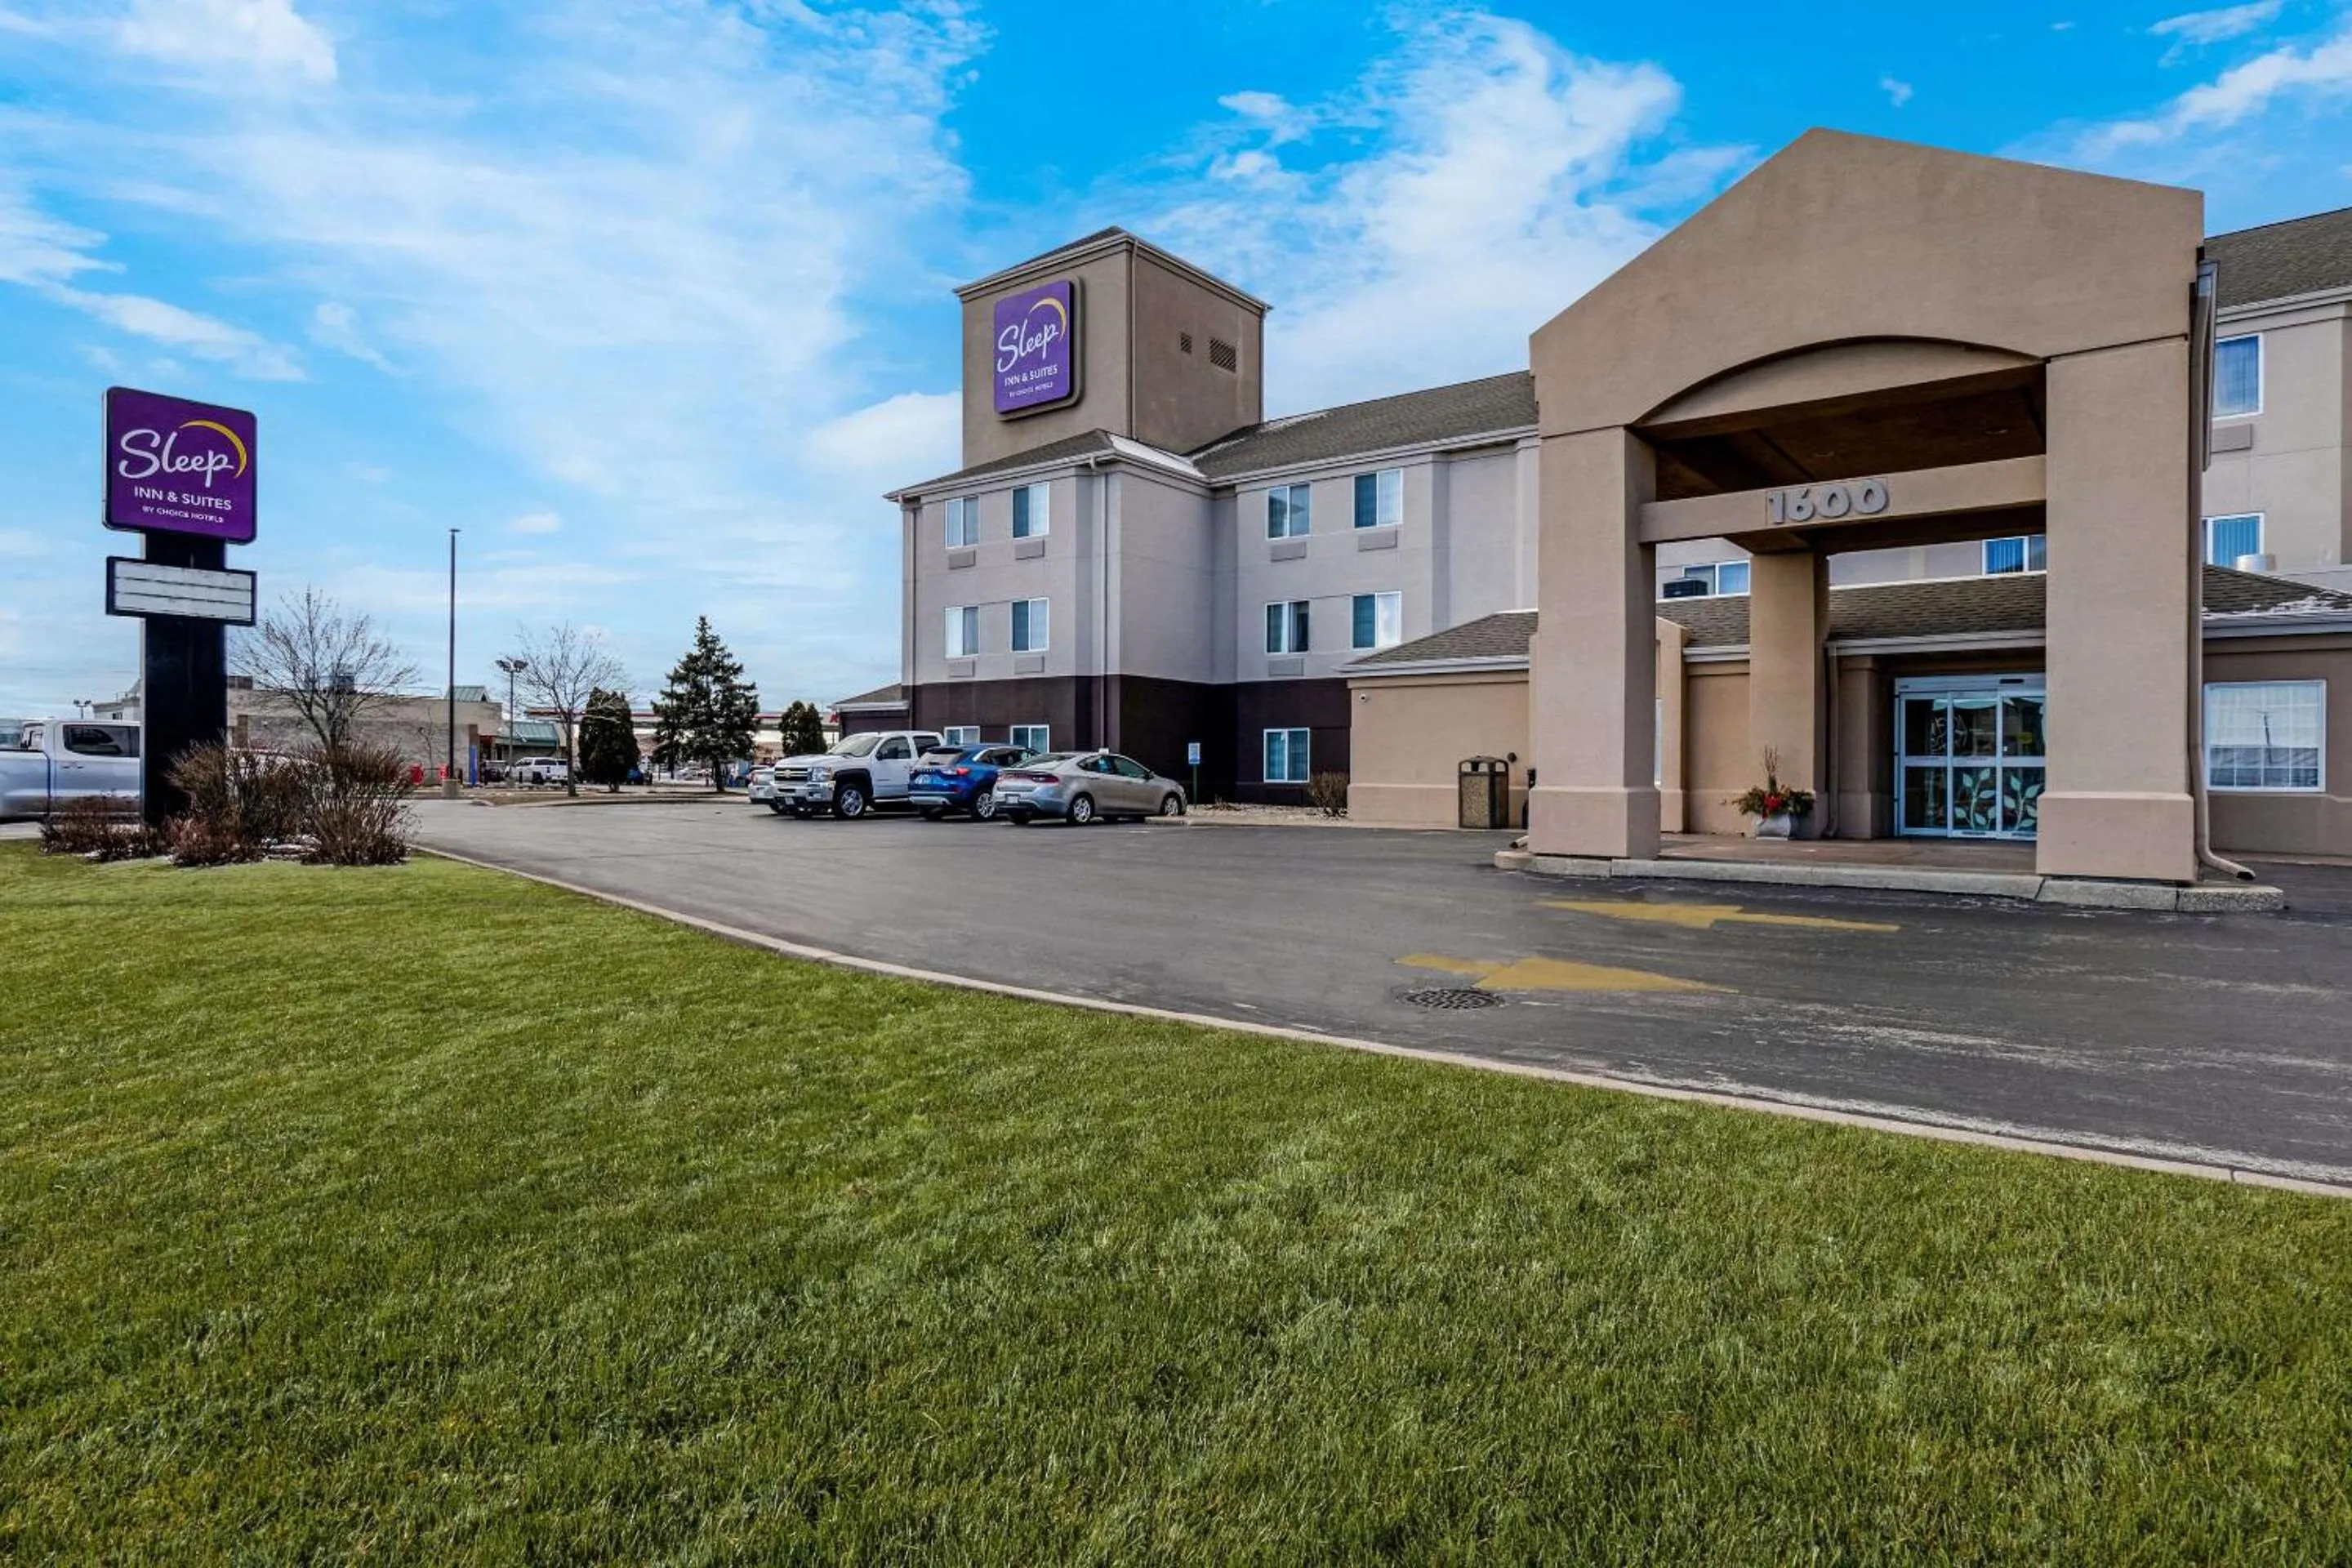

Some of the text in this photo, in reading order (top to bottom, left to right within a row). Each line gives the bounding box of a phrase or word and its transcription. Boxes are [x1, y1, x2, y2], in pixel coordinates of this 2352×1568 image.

[997, 318, 1059, 373] Sleep
[1004, 363, 1058, 386] INN & SUITES
[118, 428, 234, 488] Sleep
[134, 485, 233, 510] INN & SUITES
[142, 505, 225, 523] BY CHOICE HOTELS
[1768, 478, 1889, 525] 1600
